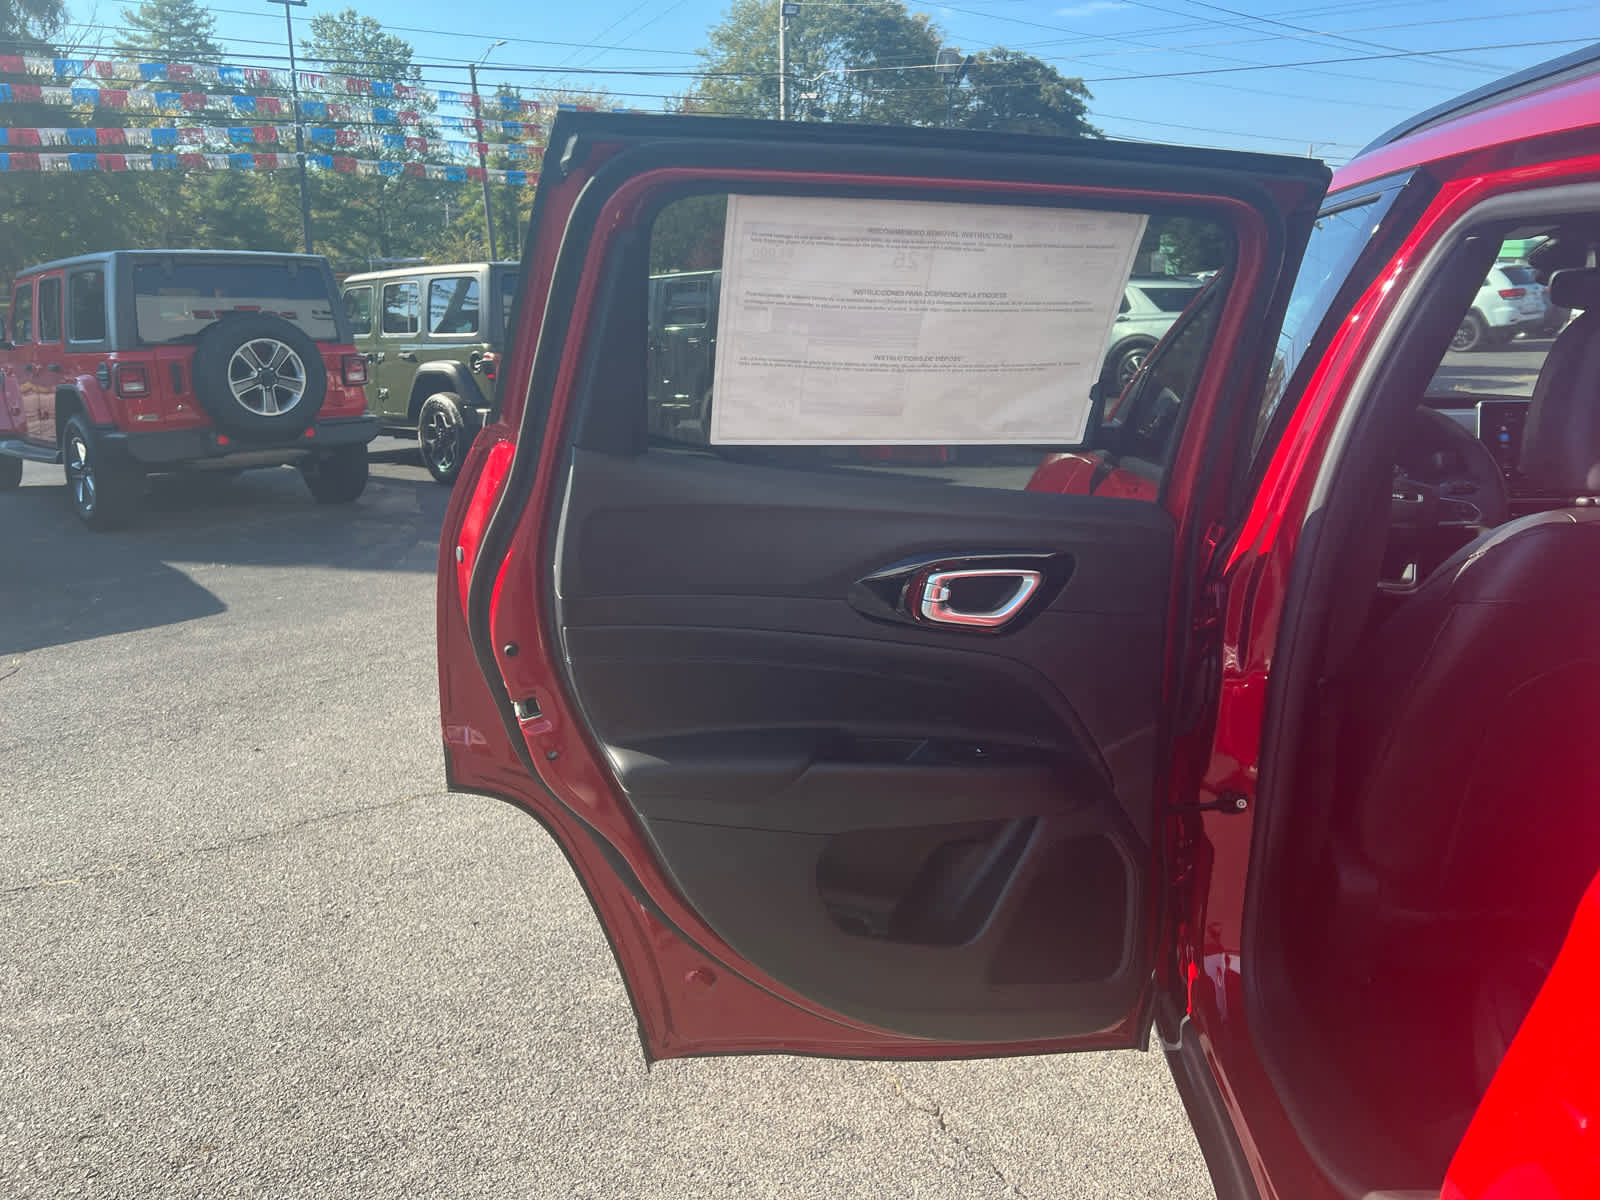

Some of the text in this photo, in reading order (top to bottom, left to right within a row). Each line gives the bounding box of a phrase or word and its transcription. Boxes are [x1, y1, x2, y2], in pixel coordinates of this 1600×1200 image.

[961, 231, 1013, 241] INSTRUCTIONS
[853, 288, 904, 297] INSTRUCCIONES
[905, 289, 923, 297] PARA
[873, 353, 923, 362] INSTRUCTIONS
